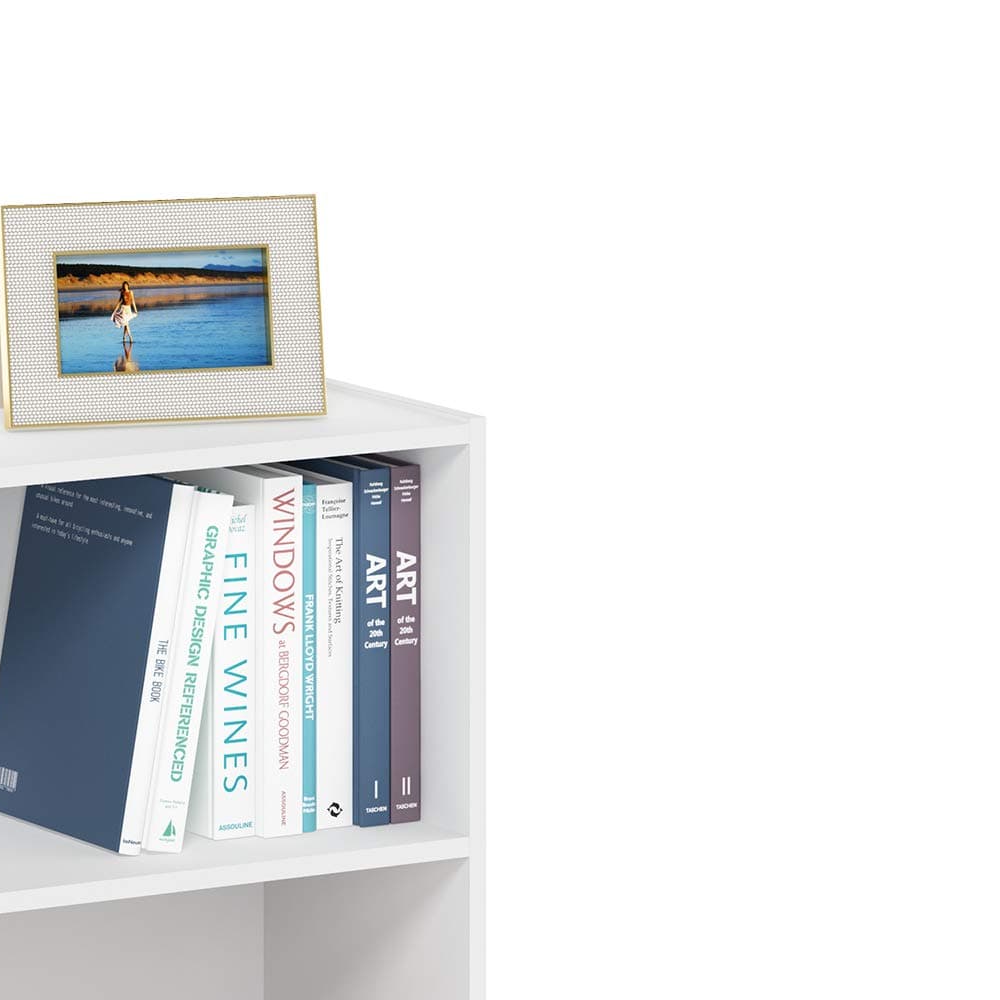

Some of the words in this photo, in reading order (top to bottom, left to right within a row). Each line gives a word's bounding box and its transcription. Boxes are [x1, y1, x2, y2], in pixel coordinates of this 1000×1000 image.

[335, 538, 344, 554] The
[198, 525, 219, 600] GRAPHIC
[272, 488, 296, 635] WINDOWS
[335, 557, 344, 572] Art
[335, 574, 344, 584] of
[366, 554, 386, 608] ART
[396, 551, 416, 605] ART
[224, 553, 248, 641] FINE
[334, 586, 344, 624] Knitting
[304, 594, 314, 633] FRANK
[367, 619, 374, 627] of
[375, 618, 385, 626] the
[397, 616, 404, 624] of
[405, 615, 415, 624] the
[157, 640, 168, 655] THE
[187, 605, 208, 667] DESIGN
[278, 640, 286, 648] at
[364, 640, 388, 649] Century
[394, 637, 418, 646] Century
[154, 658, 166, 678] BIKE
[304, 634, 314, 672] LLOYD
[150, 681, 162, 703] BOOK
[278, 650, 290, 708] BERGDORF
[304, 674, 314, 720] WRIGHT
[170, 672, 198, 782] REFERENCED
[224, 659, 248, 793] WINES
[278, 710, 290, 770] GOODMAN
[402, 776, 410, 796] II
[396, 802, 418, 810] TASCHEN
[218, 821, 253, 832] ASSOULINE
